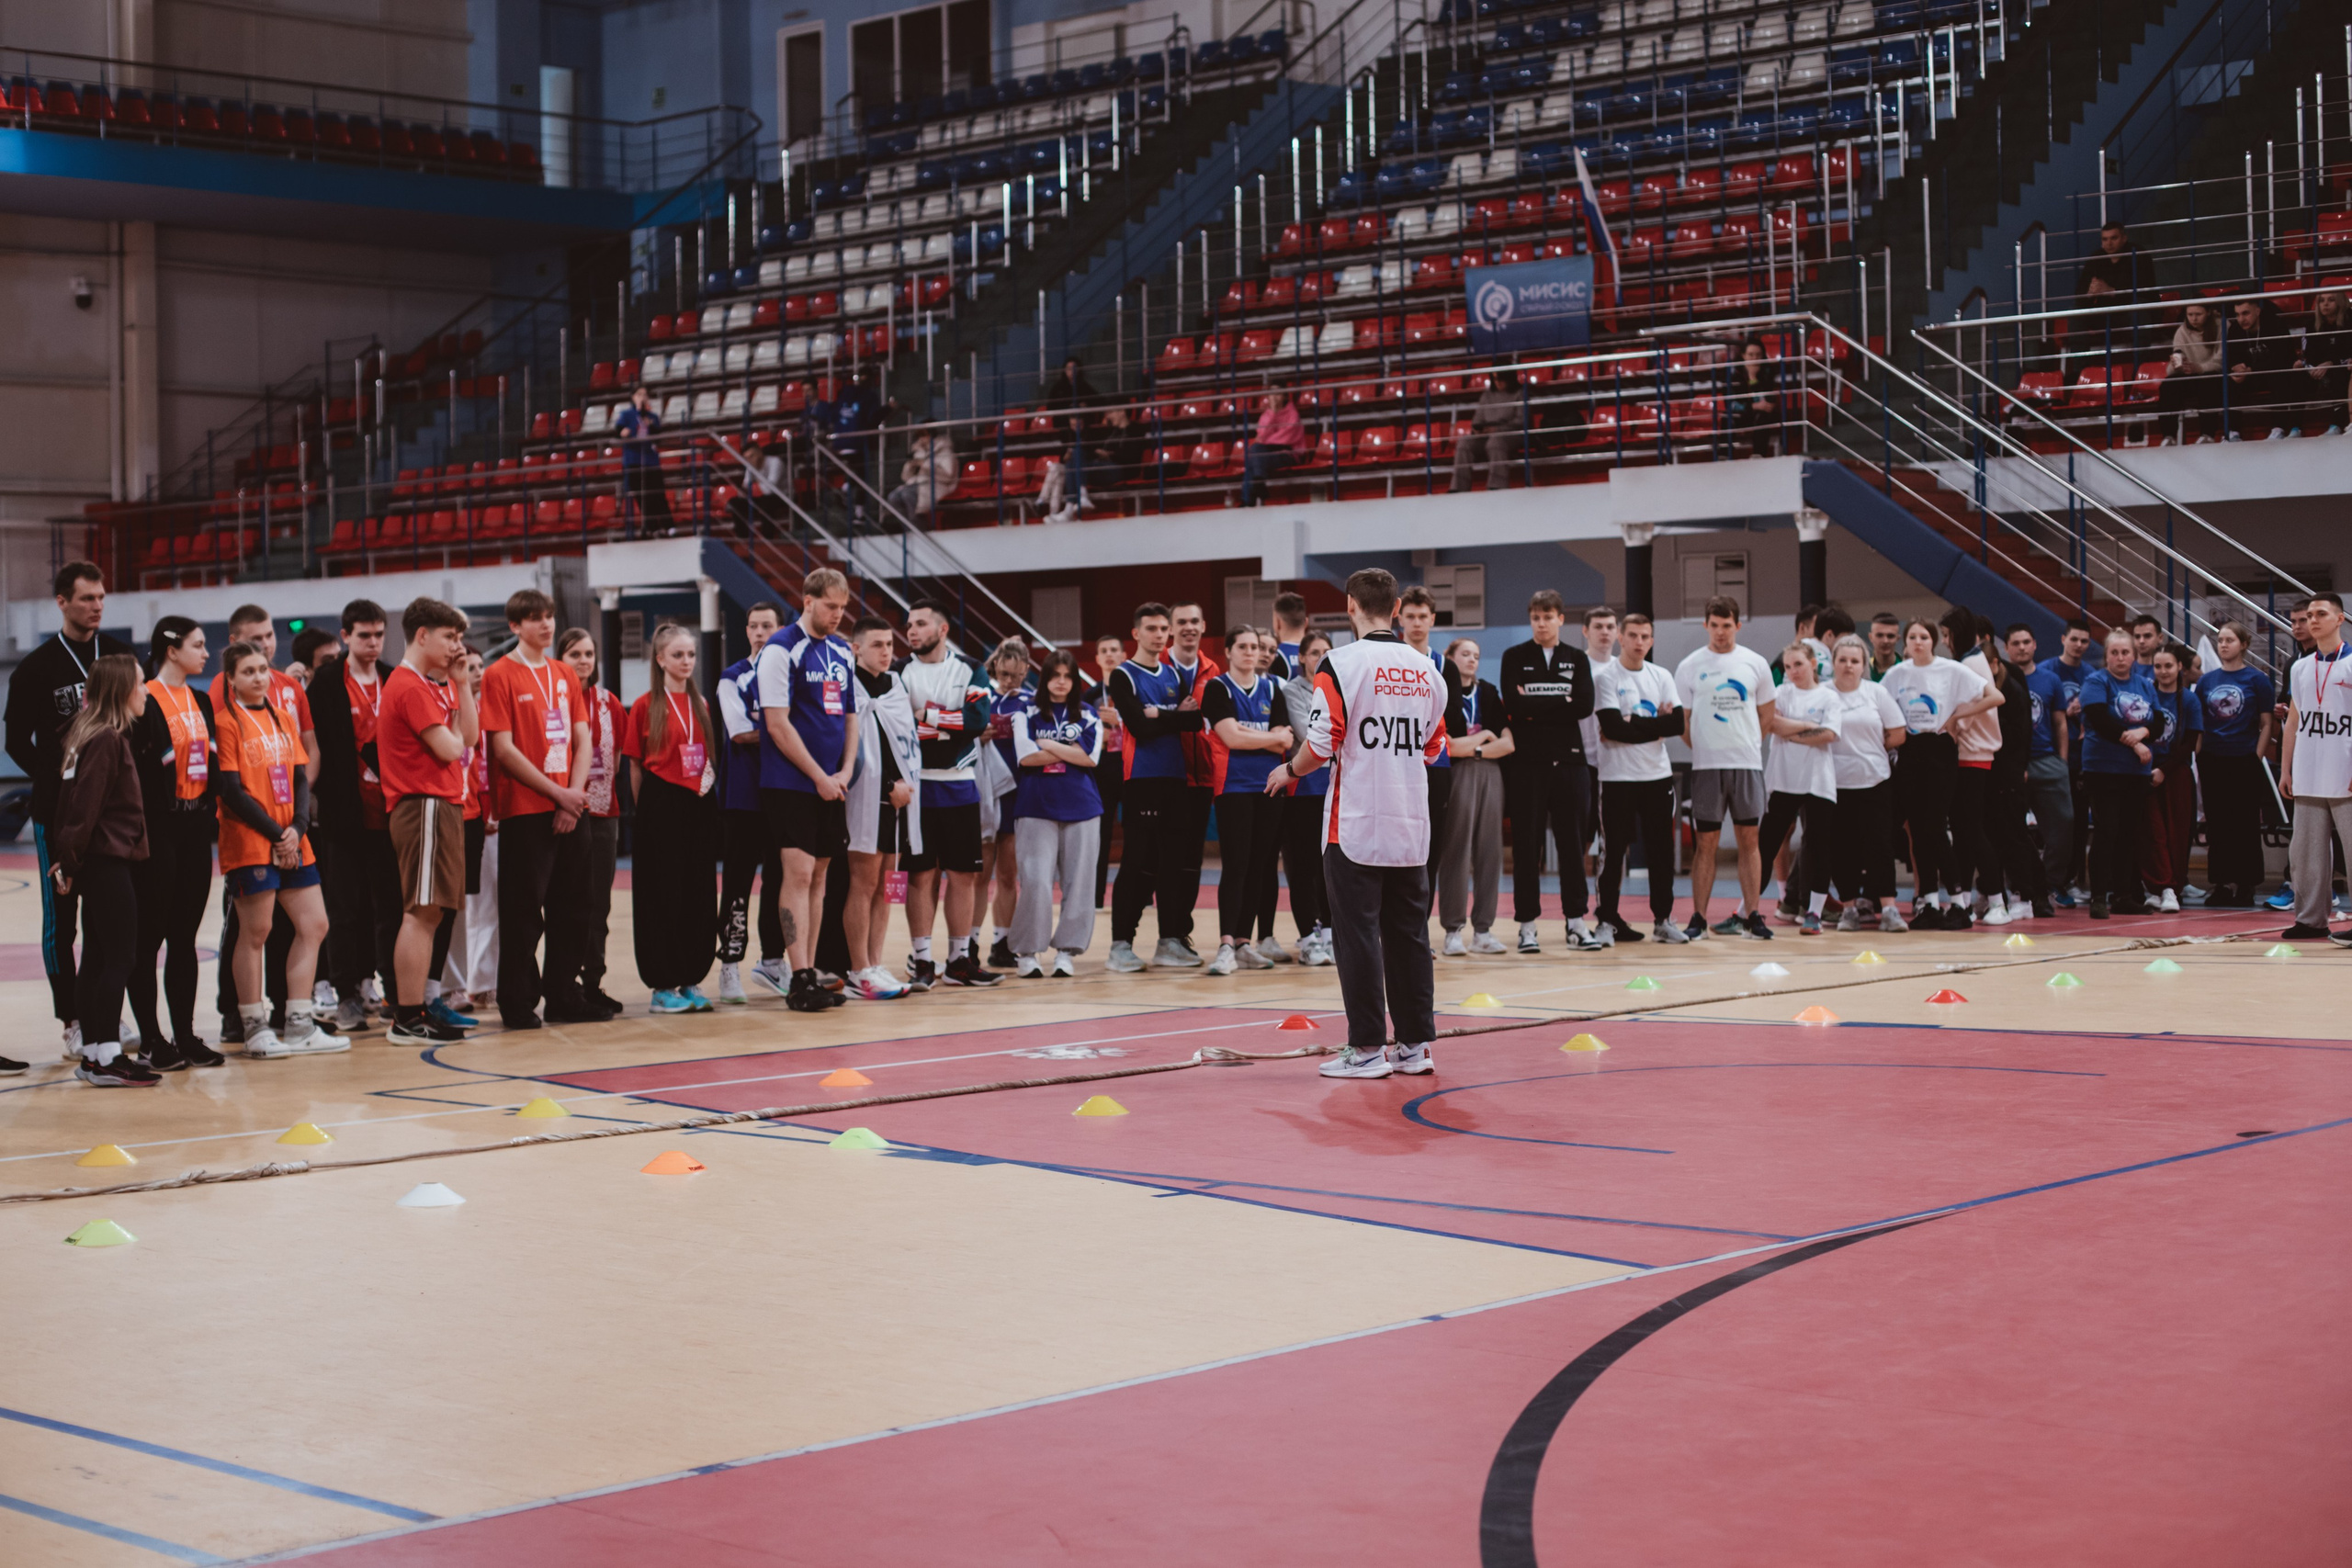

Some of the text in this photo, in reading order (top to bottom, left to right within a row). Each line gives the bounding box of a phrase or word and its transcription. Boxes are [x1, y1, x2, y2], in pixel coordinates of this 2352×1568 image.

[1519, 281, 1586, 301] МИСИС
[1374, 667, 1430, 685] АССК
[1374, 684, 1430, 698] РОССИИ
[2300, 711, 2351, 739] УДЬЯ
[1359, 716, 1430, 757] СУДЬ
